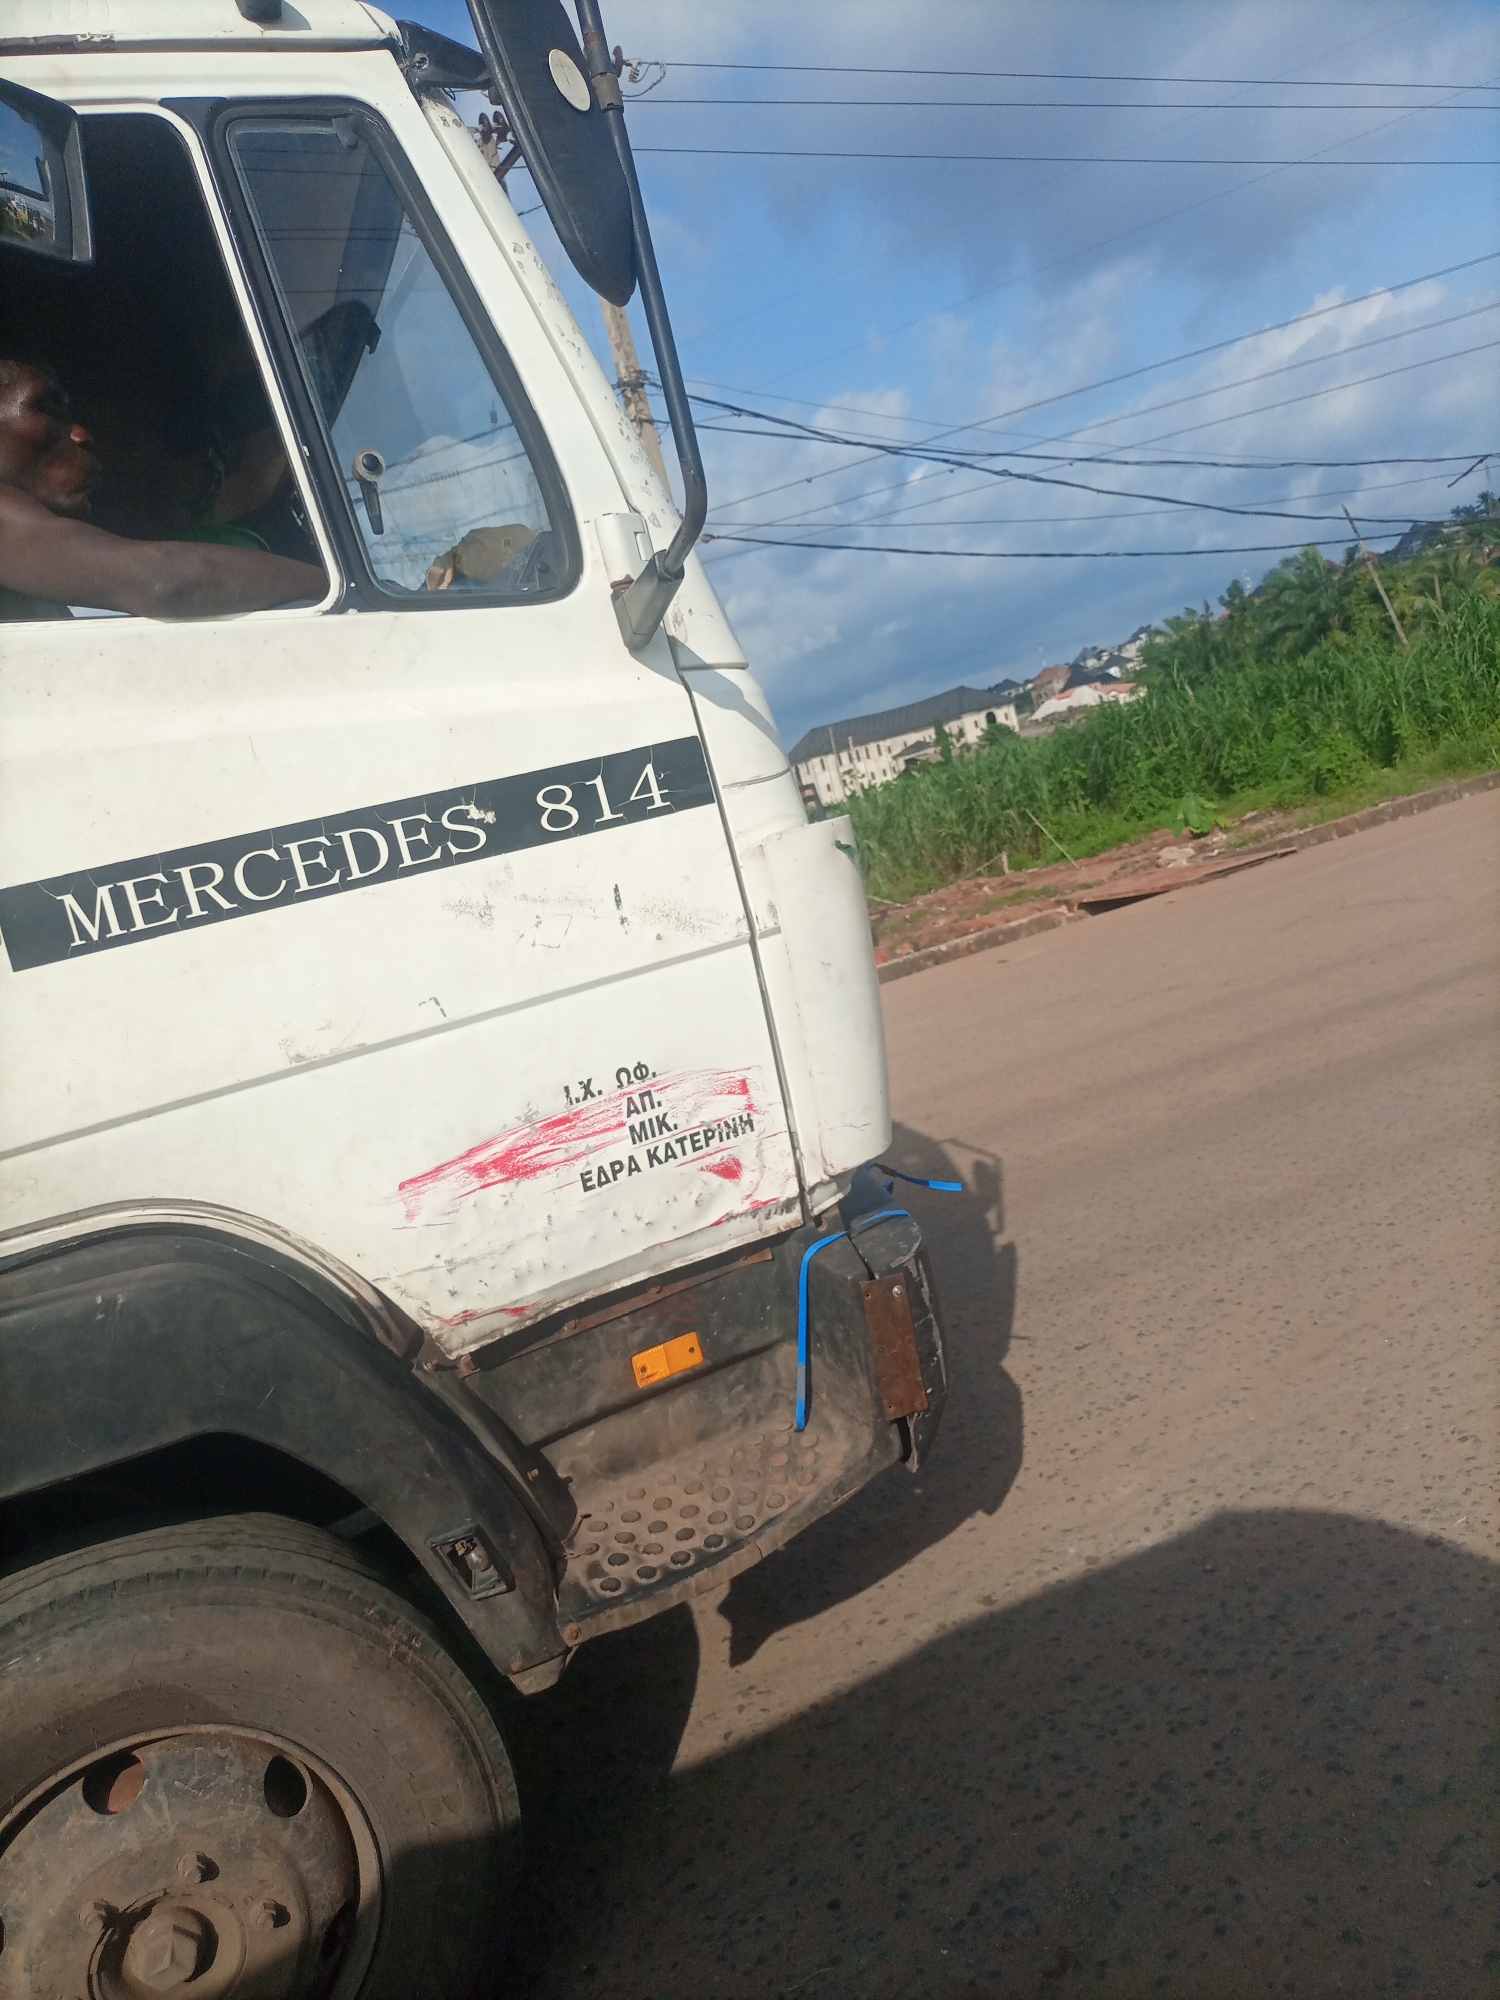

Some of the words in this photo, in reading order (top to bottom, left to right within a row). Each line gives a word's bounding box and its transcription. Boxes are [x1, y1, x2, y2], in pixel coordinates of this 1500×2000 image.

[57, 803, 488, 946] MERCEDES
[535, 762, 670, 833] 814
[626, 1089, 662, 1119] ΑΠ.
[628, 1111, 679, 1145] ΜΙΚ.
[579, 1154, 642, 1193] ΕΔΡΑ
